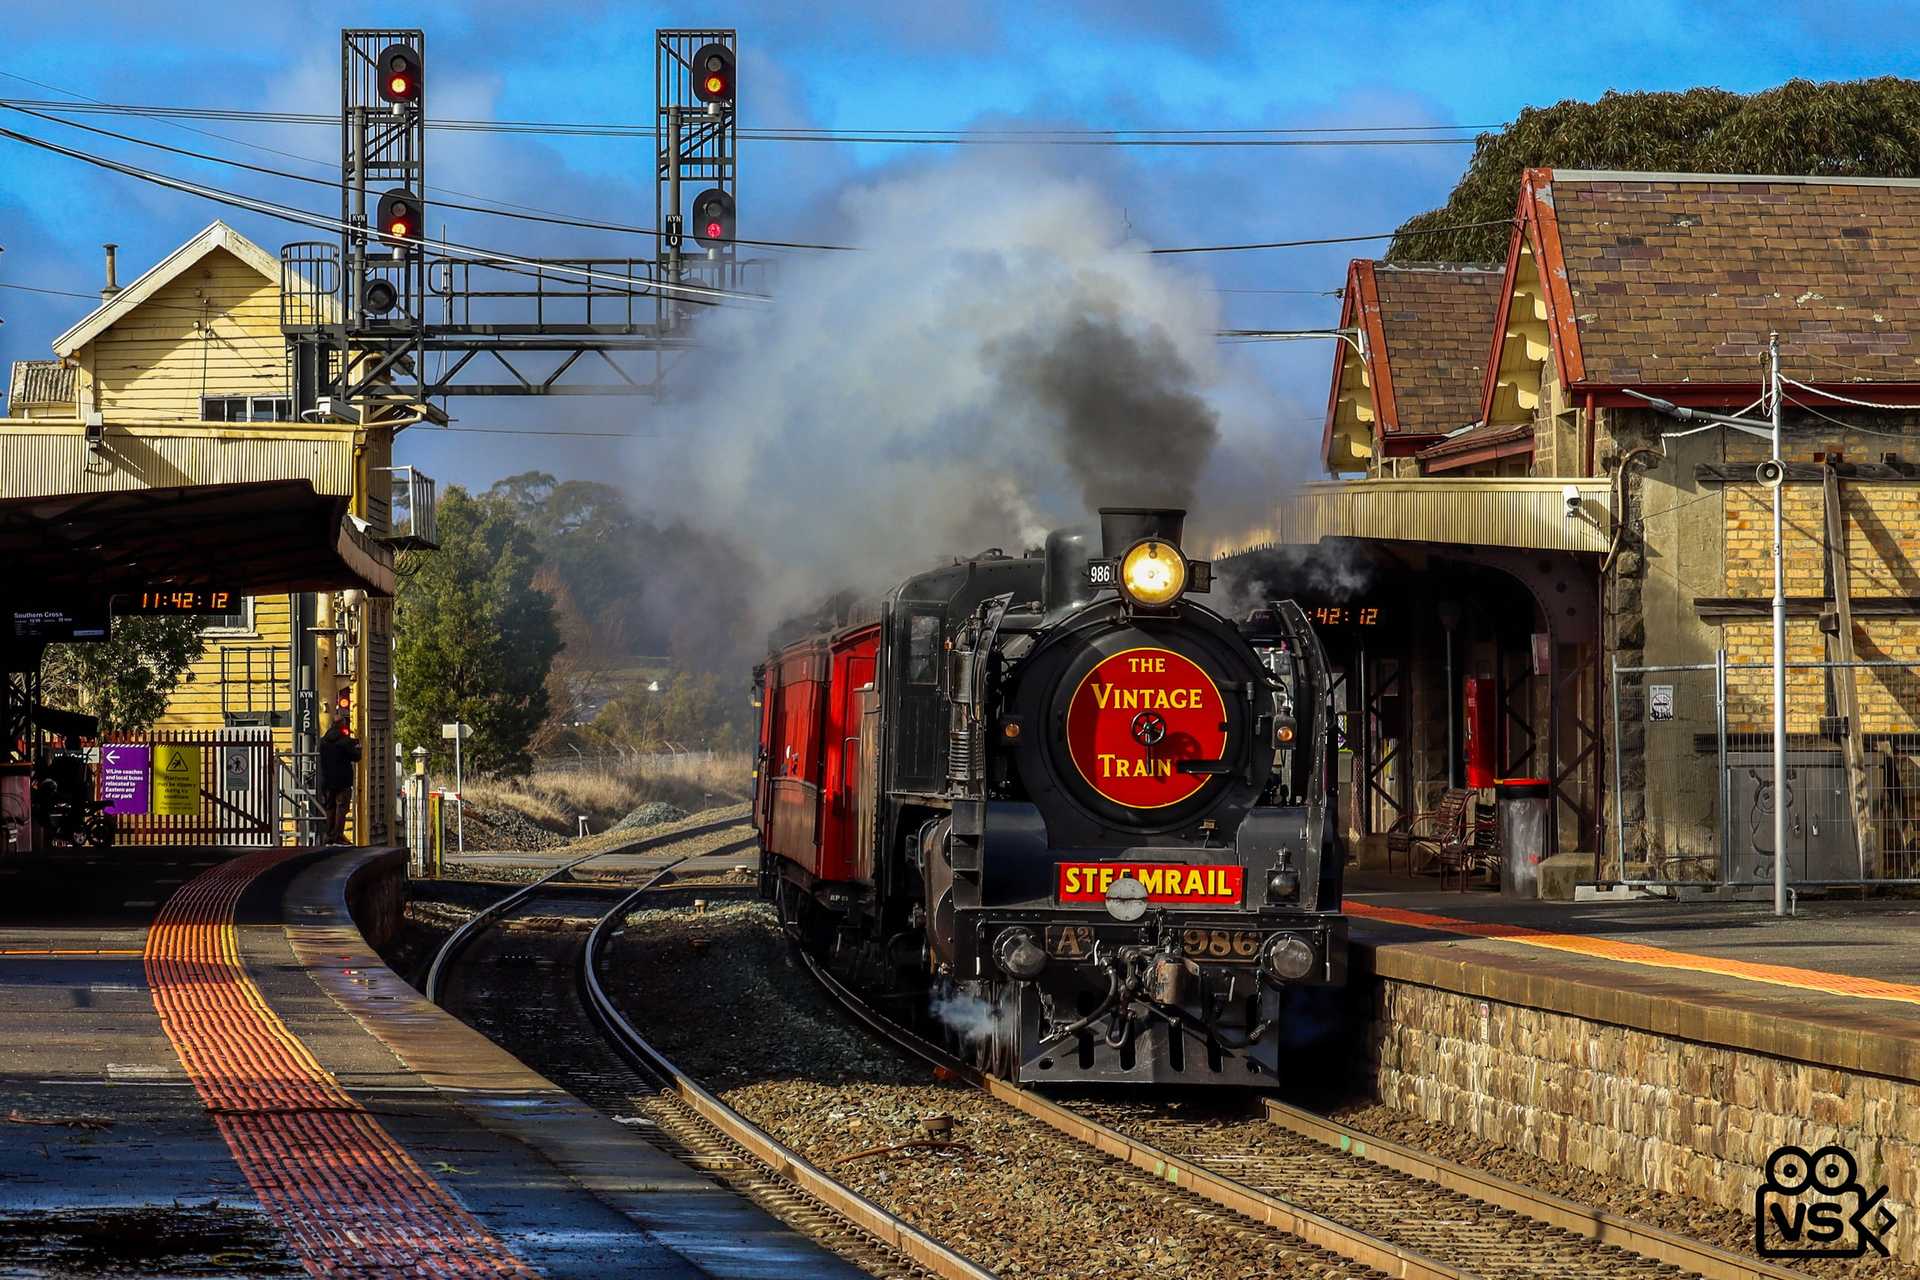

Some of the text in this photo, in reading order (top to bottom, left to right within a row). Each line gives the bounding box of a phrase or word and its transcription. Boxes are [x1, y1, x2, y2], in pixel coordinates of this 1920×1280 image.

[1089, 565, 1110, 583] 986
[14, 611, 63, 619] Southern Cross
[1128, 658, 1166, 673] THE
[1090, 683, 1203, 709] VINTAGE
[1097, 754, 1172, 778] TRAIN
[1183, 929, 1259, 957] 986
